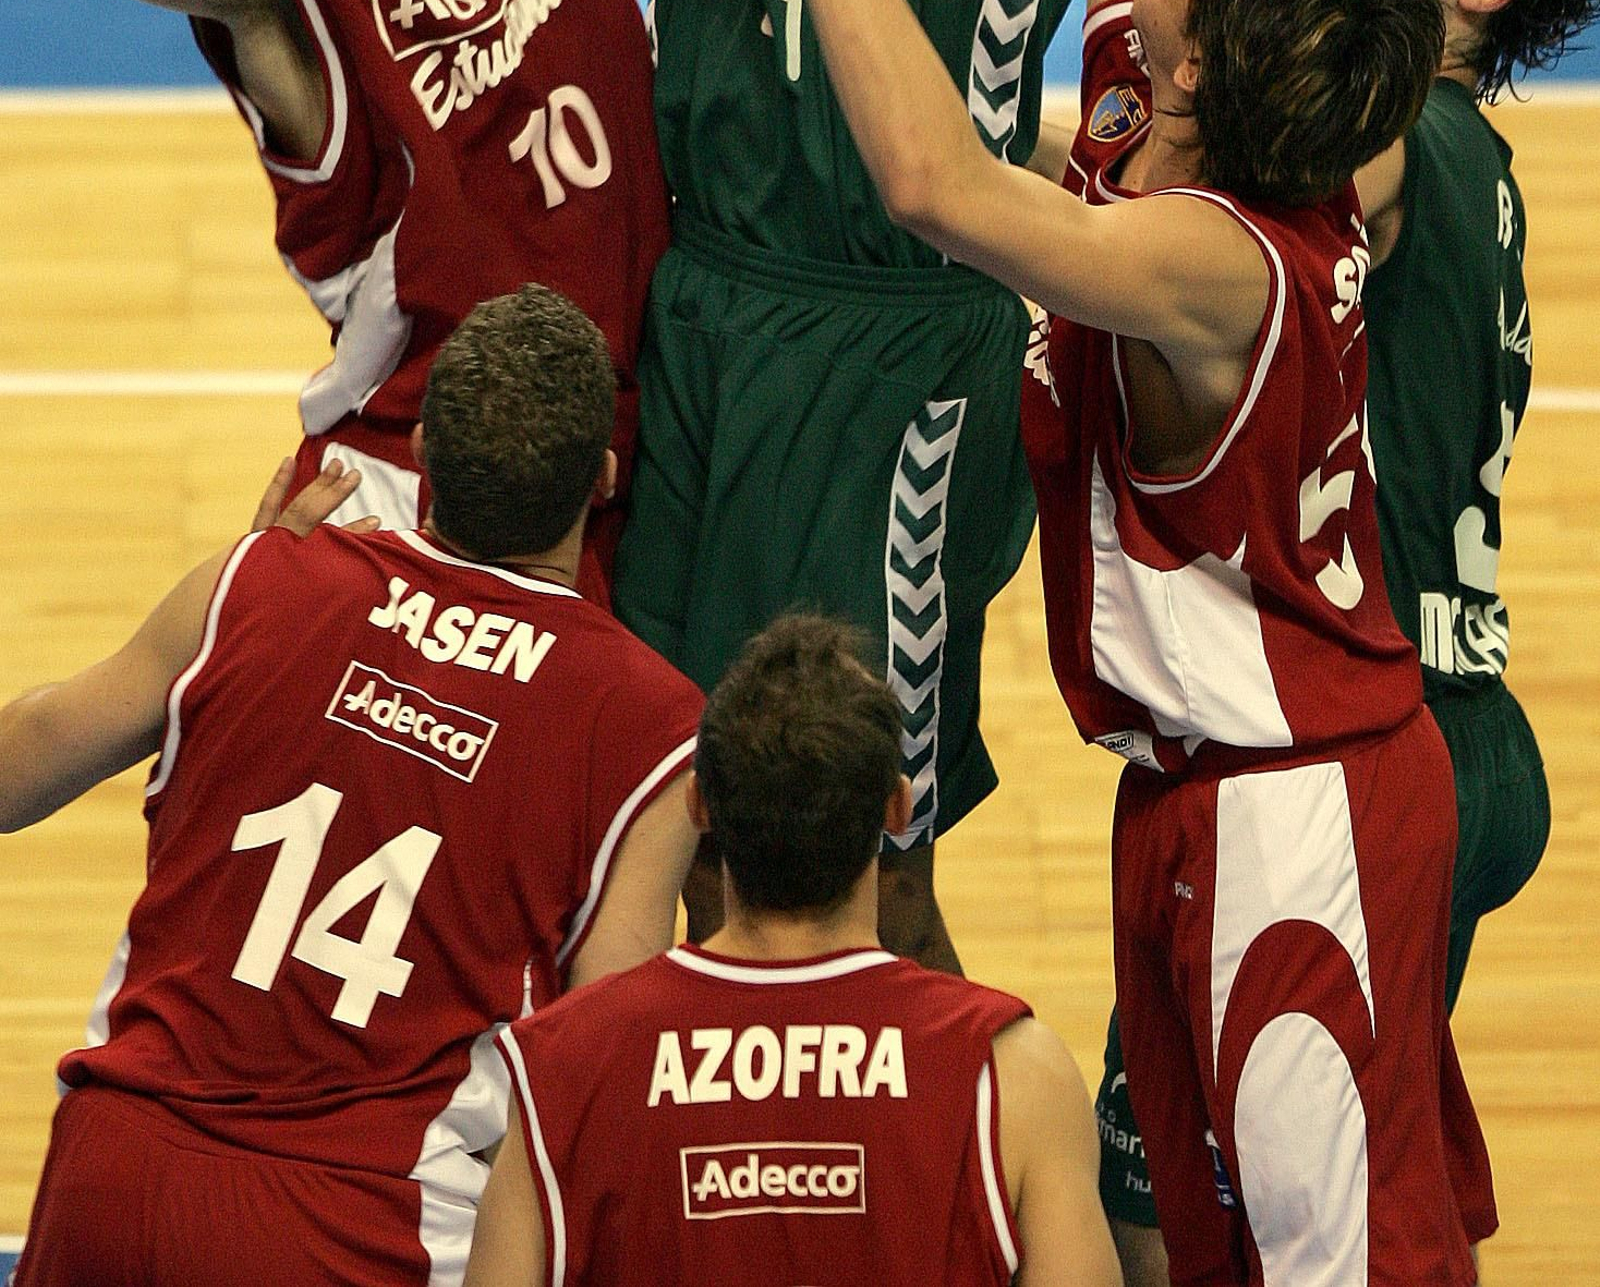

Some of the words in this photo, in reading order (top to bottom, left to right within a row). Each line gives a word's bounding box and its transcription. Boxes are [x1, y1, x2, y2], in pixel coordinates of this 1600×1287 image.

[508, 85, 612, 209] 10
[368, 576, 557, 683] JASEN
[343, 680, 484, 761] Adecco
[231, 782, 443, 1029] 14
[647, 1025, 908, 1107] AZOFRA
[692, 1153, 860, 1202] Adecco
